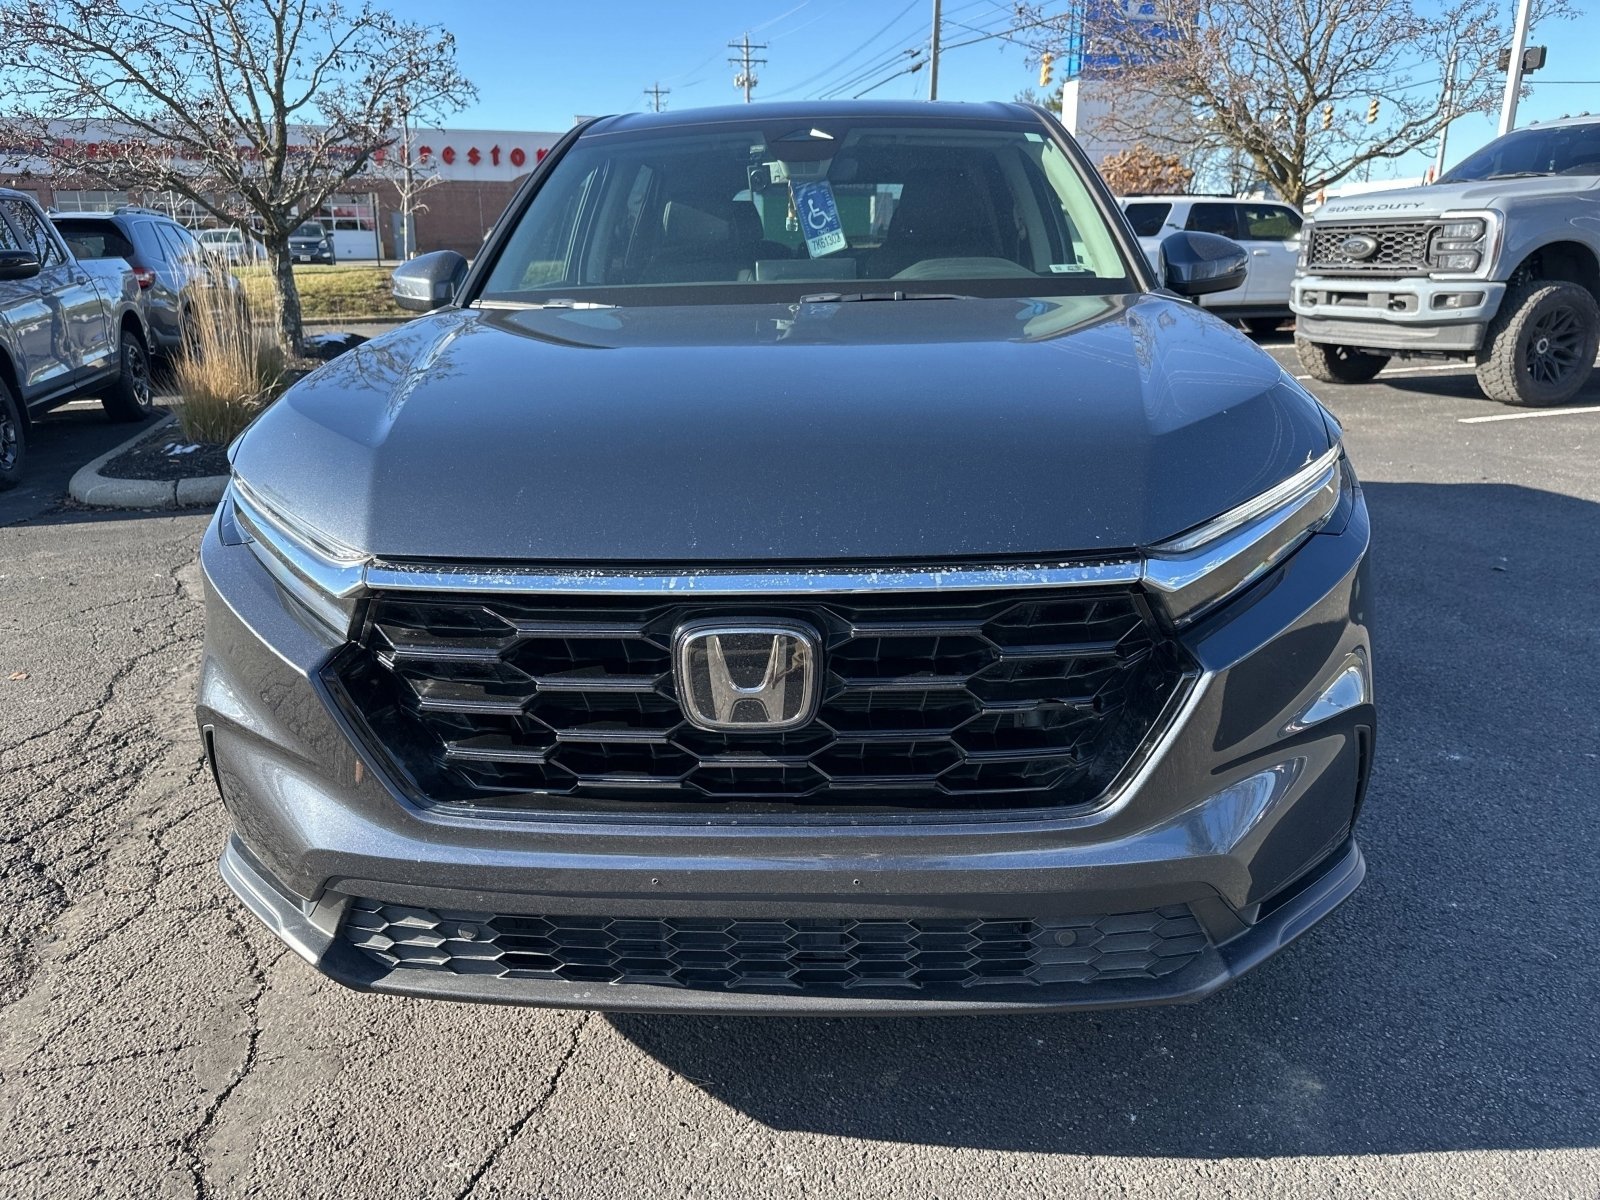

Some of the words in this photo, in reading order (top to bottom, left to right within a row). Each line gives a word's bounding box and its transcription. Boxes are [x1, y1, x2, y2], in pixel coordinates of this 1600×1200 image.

[373, 143, 550, 167] Freston
[1327, 203, 1375, 213] SUPER
[1377, 202, 1424, 211] DUTY
